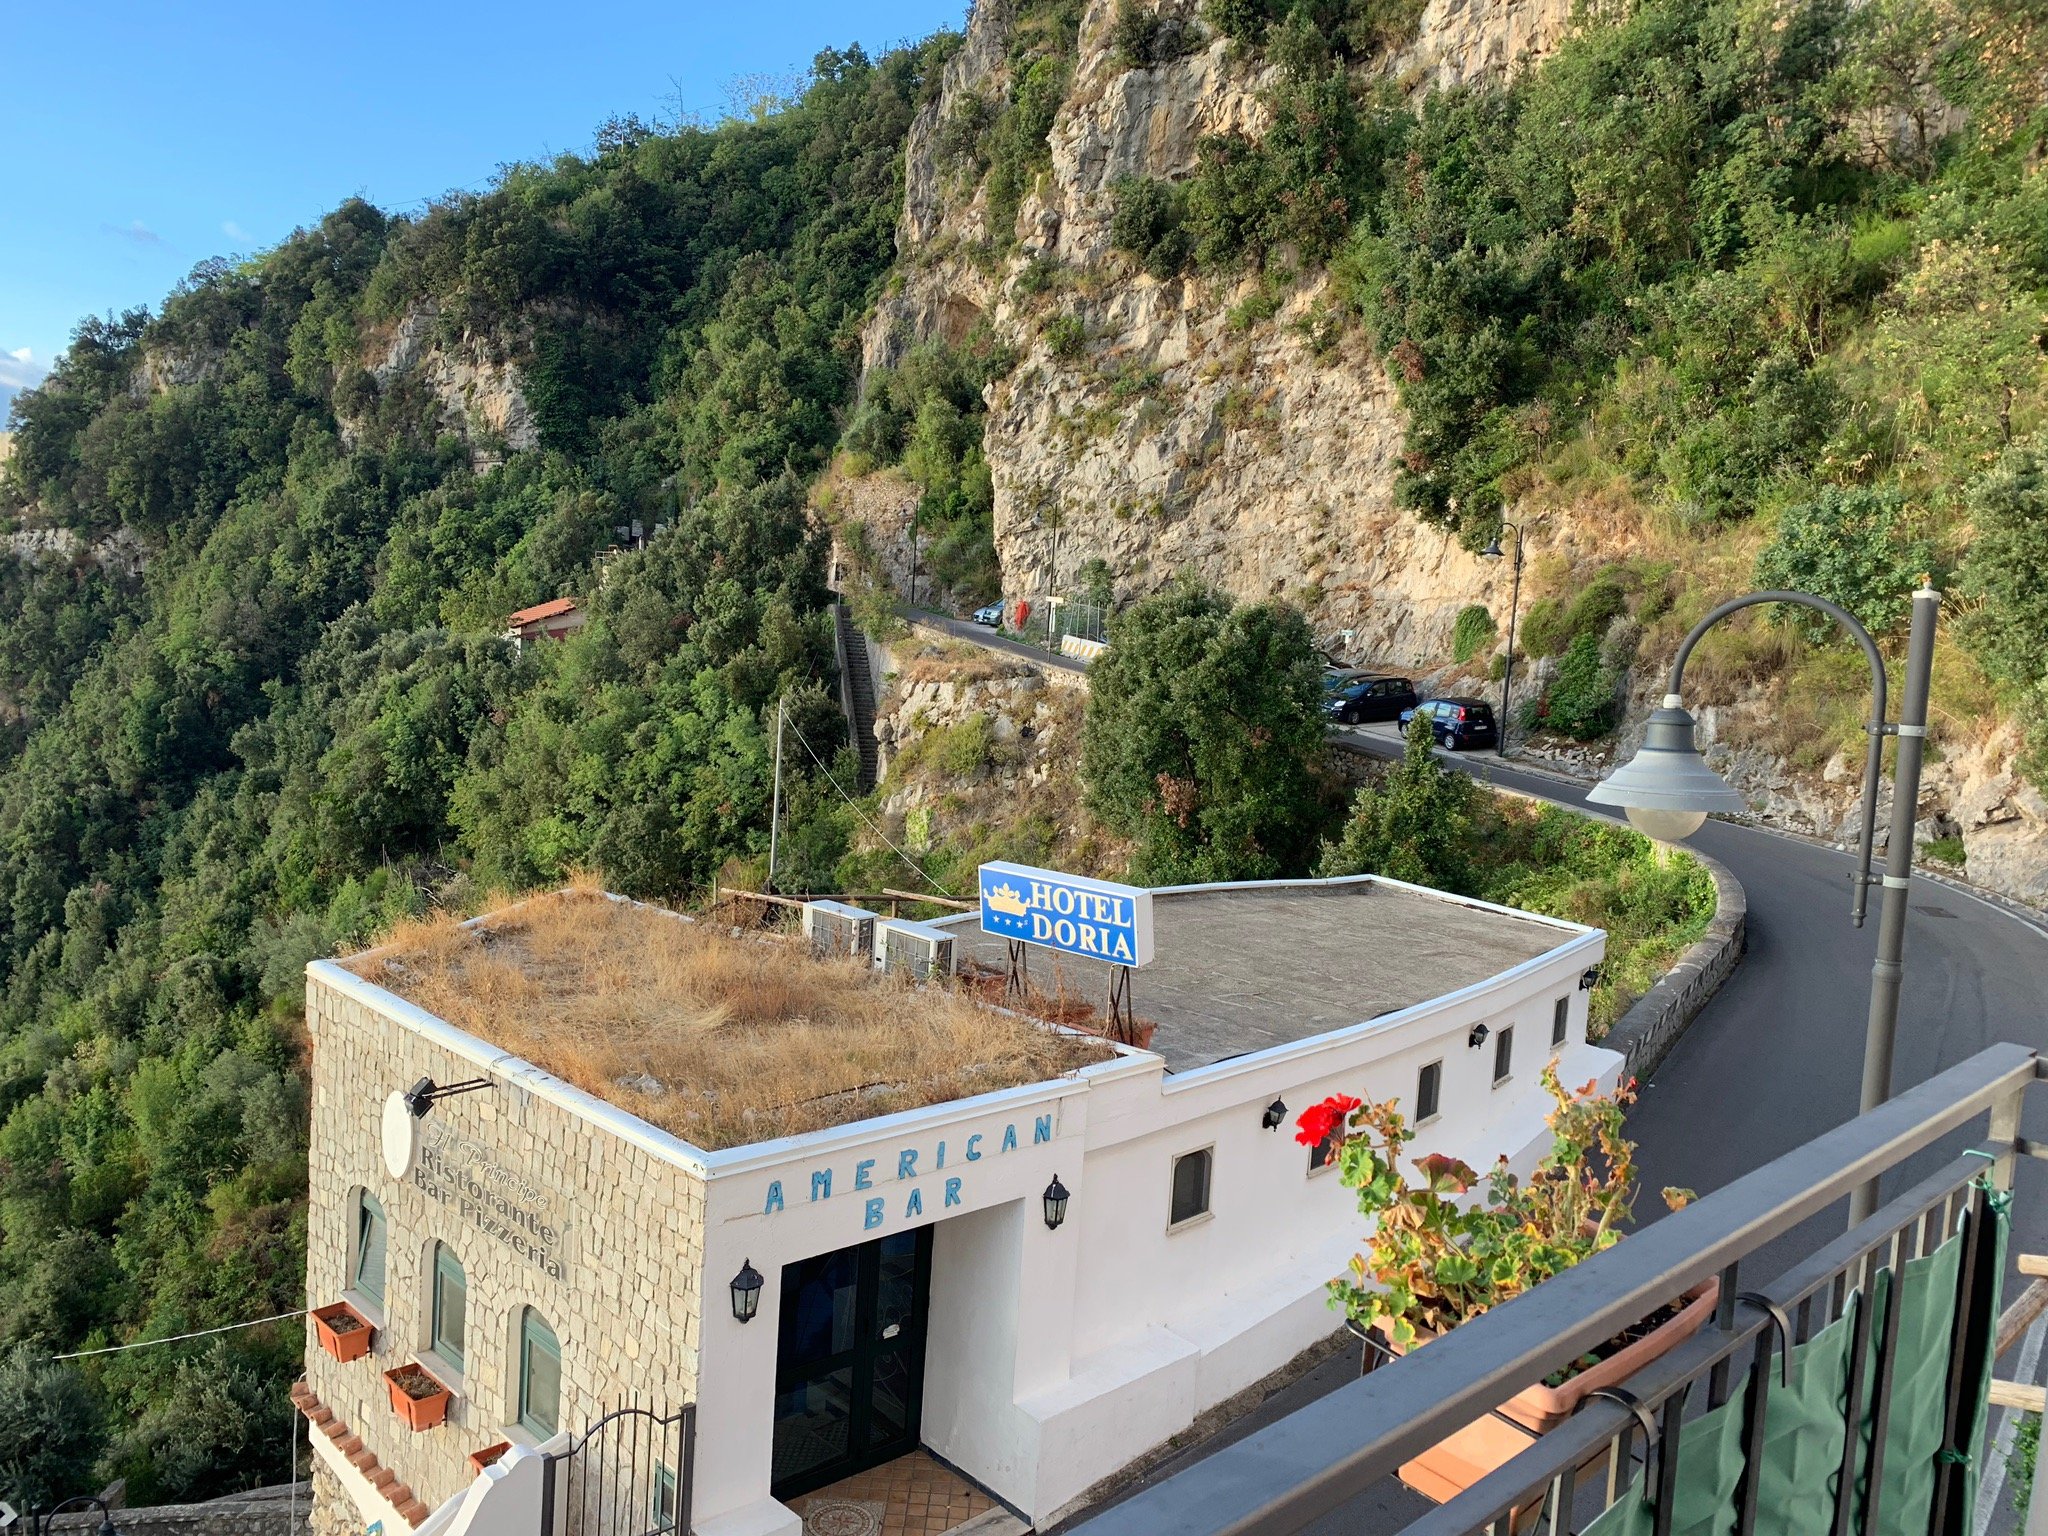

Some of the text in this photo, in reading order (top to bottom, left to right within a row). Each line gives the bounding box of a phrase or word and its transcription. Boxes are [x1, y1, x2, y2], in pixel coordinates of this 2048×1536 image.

[1029, 881, 1132, 928] HOTEL
[1031, 913, 1134, 961] DORIA
[421, 1145, 555, 1246] Ristorante
[459, 1140, 549, 1210] Principe
[764, 1114, 1052, 1215] AMERICAN
[414, 1166, 562, 1281] Bar Pizzeria
[864, 1177, 962, 1230] BAR
